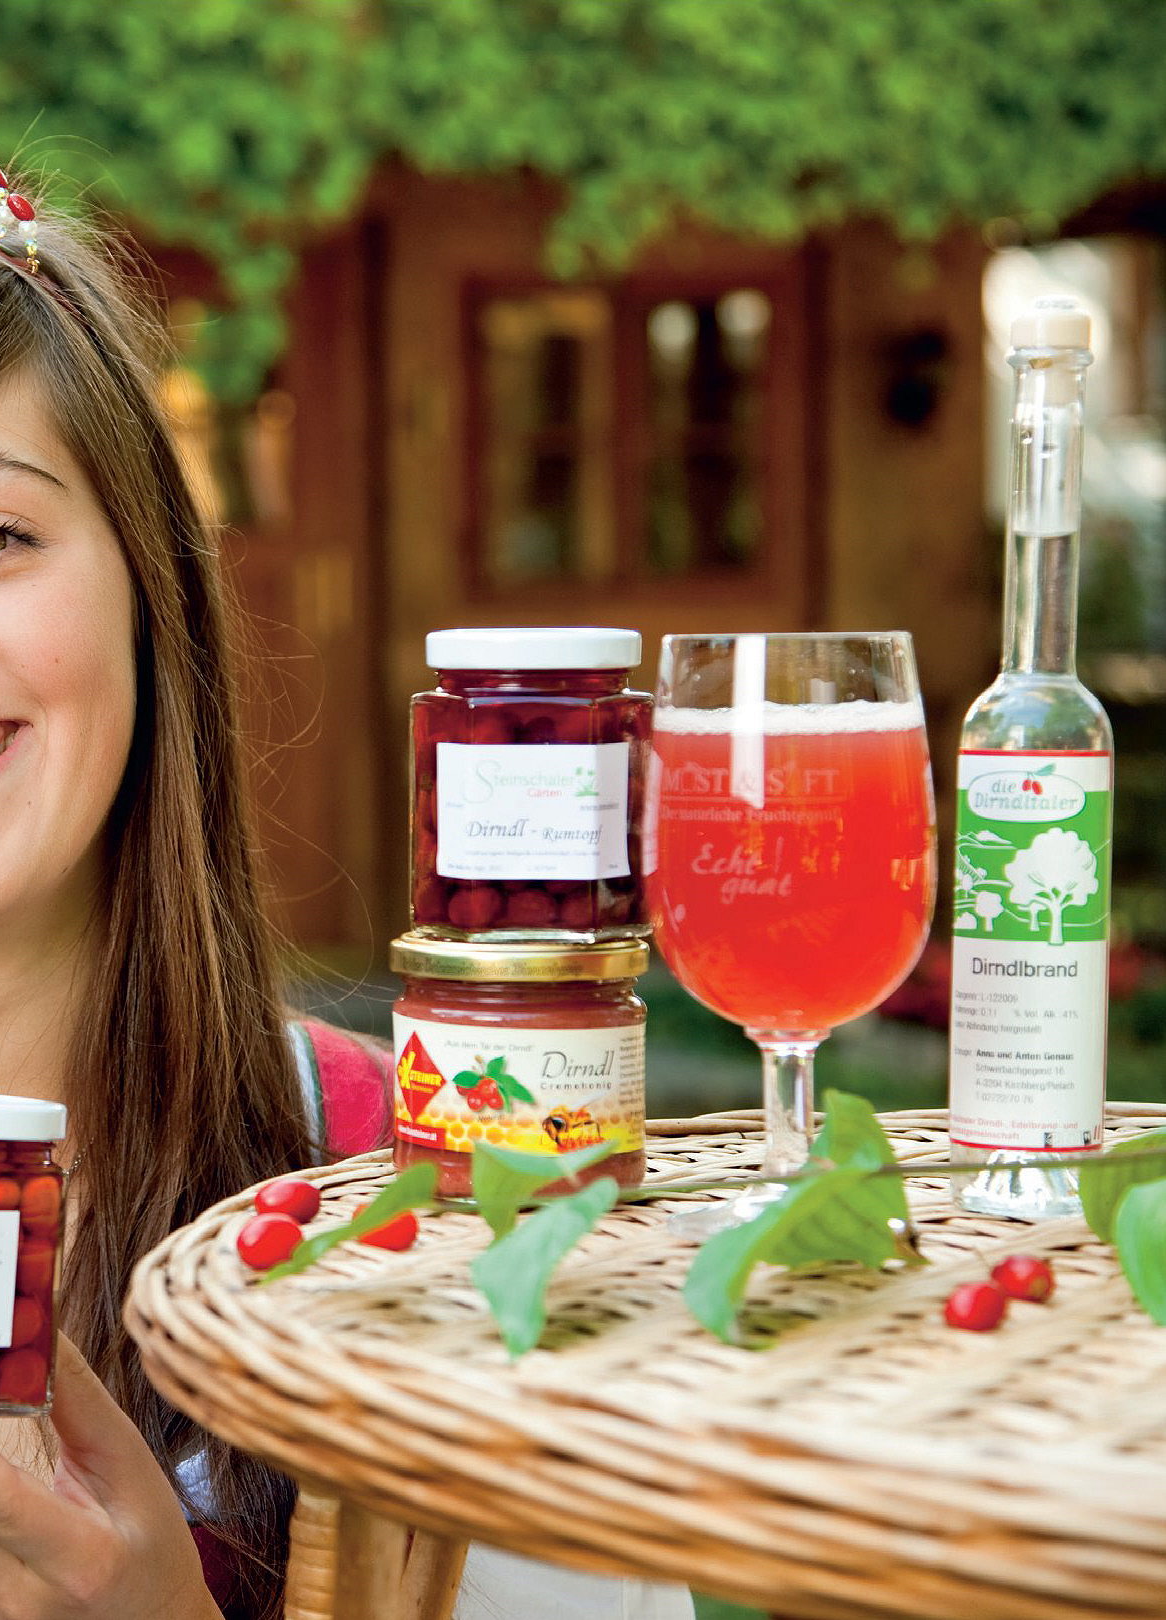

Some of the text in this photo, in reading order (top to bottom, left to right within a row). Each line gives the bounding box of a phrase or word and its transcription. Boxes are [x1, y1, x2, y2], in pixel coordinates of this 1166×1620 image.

[991, 779, 1016, 793] die
[975, 792, 1078, 811] Dirndltaler
[466, 818, 529, 837] Dirndl
[542, 824, 602, 846] Rumtopf
[971, 956, 1078, 978] Dirndlbrand
[541, 1050, 615, 1079] Dirndl
[997, 1051, 1013, 1060] und
[540, 1081, 612, 1090] Cremehonig
